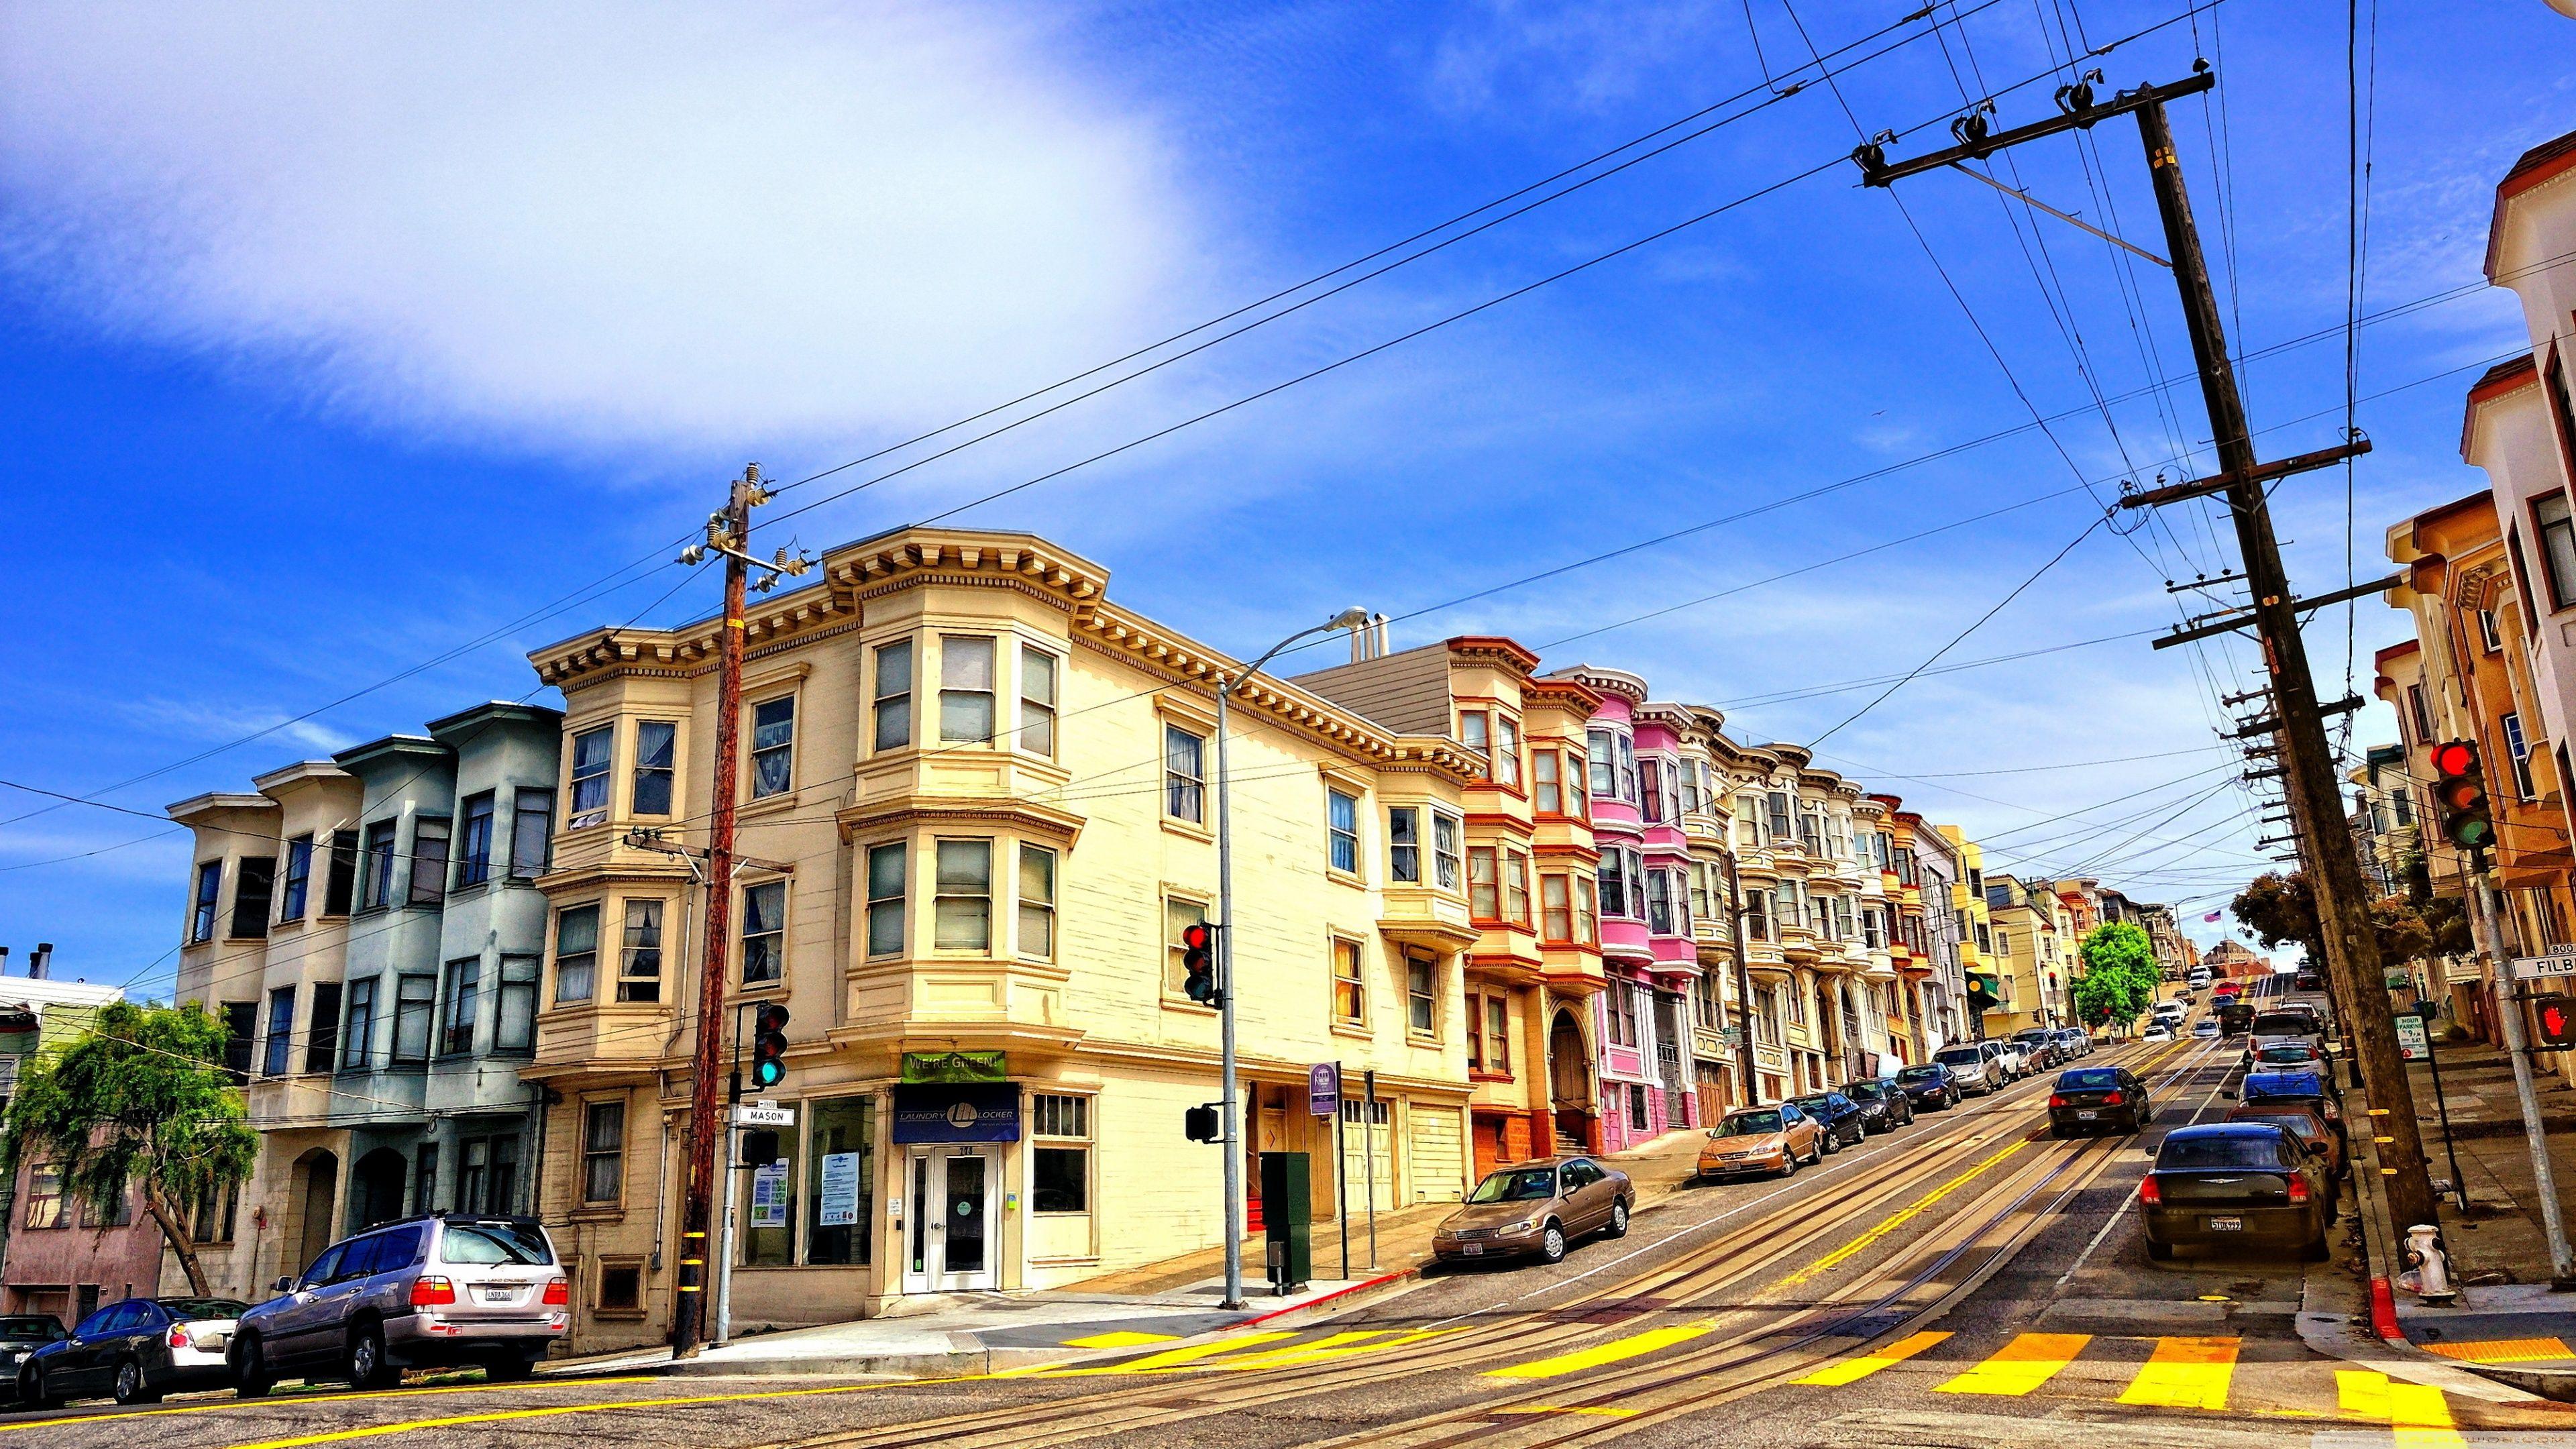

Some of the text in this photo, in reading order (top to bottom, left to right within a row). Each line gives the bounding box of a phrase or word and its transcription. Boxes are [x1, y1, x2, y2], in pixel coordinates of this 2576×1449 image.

[2552, 944, 2573, 953] 800
[2536, 958, 2576, 973] FILB
[910, 1056, 998, 1069] WE'RE GREEN!
[750, 1111, 784, 1121] MASON
[900, 1111, 1014, 1120] LAUNDRY LOCKER
